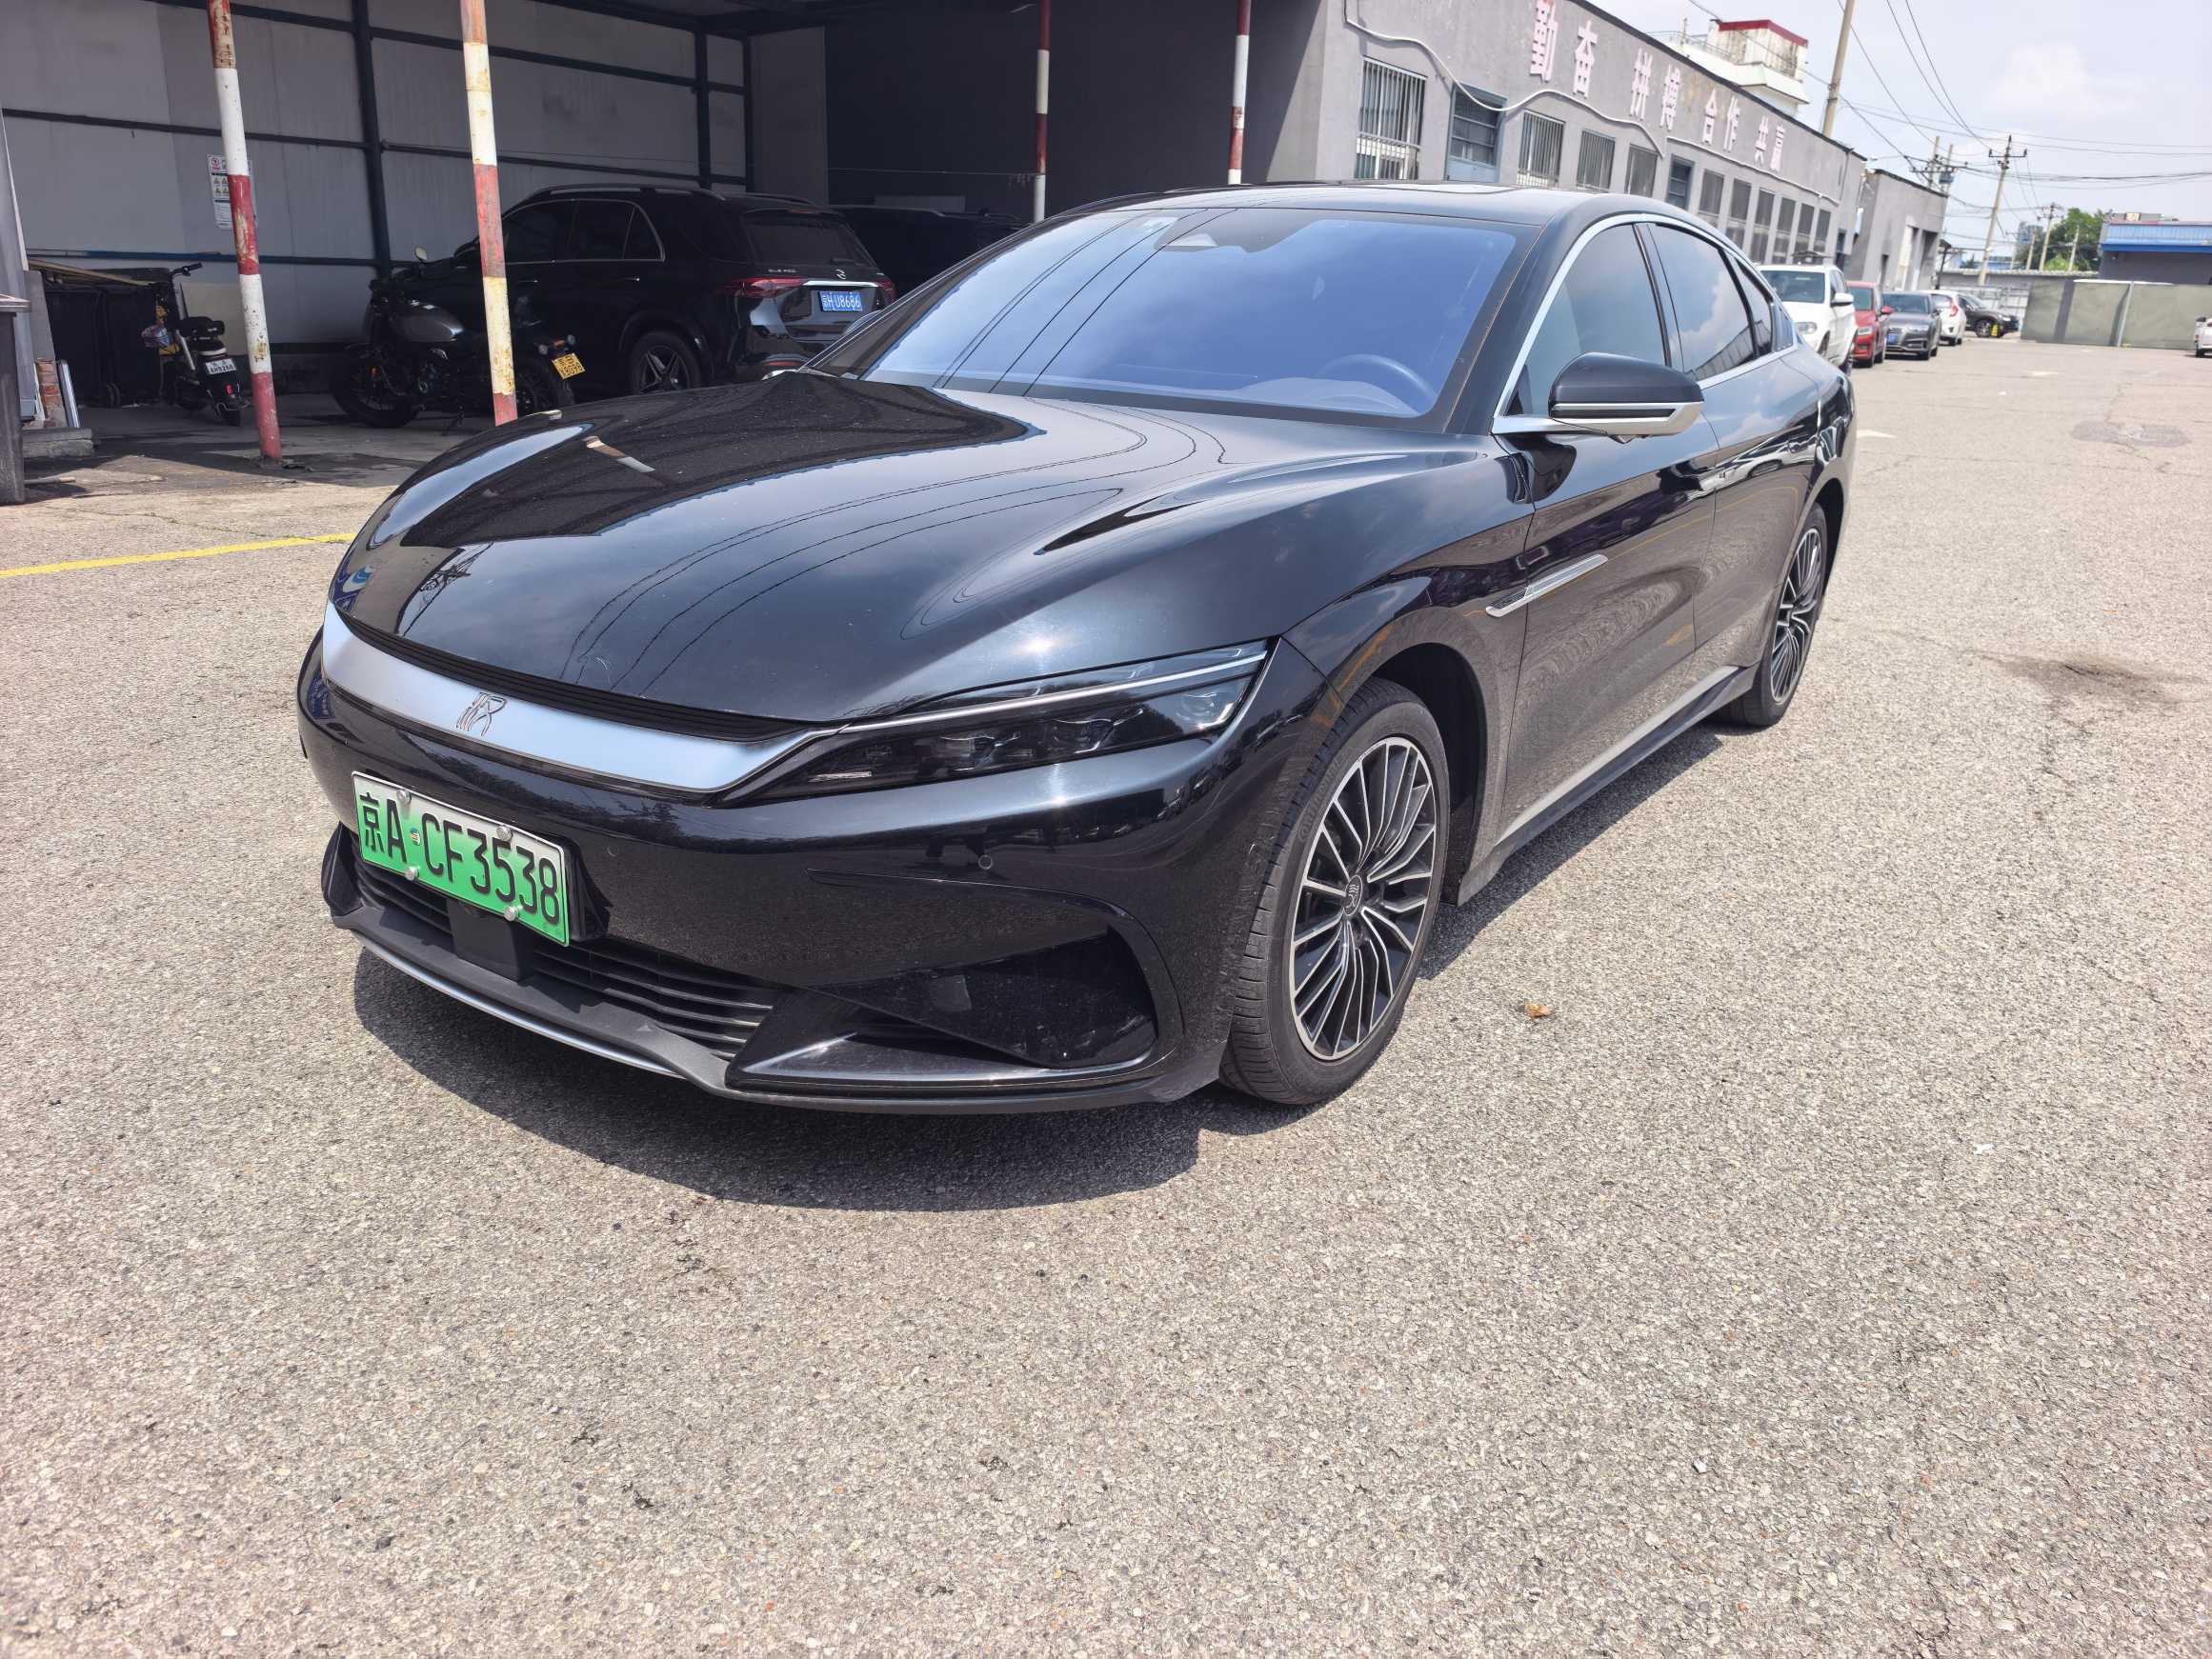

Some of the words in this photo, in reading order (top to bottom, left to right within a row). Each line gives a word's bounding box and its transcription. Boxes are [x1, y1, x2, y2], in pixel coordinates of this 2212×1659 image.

[1530, 0, 1598, 97] 勤奋
[1630, 49, 1680, 131] 拼搏
[1702, 89, 1739, 151] 合作
